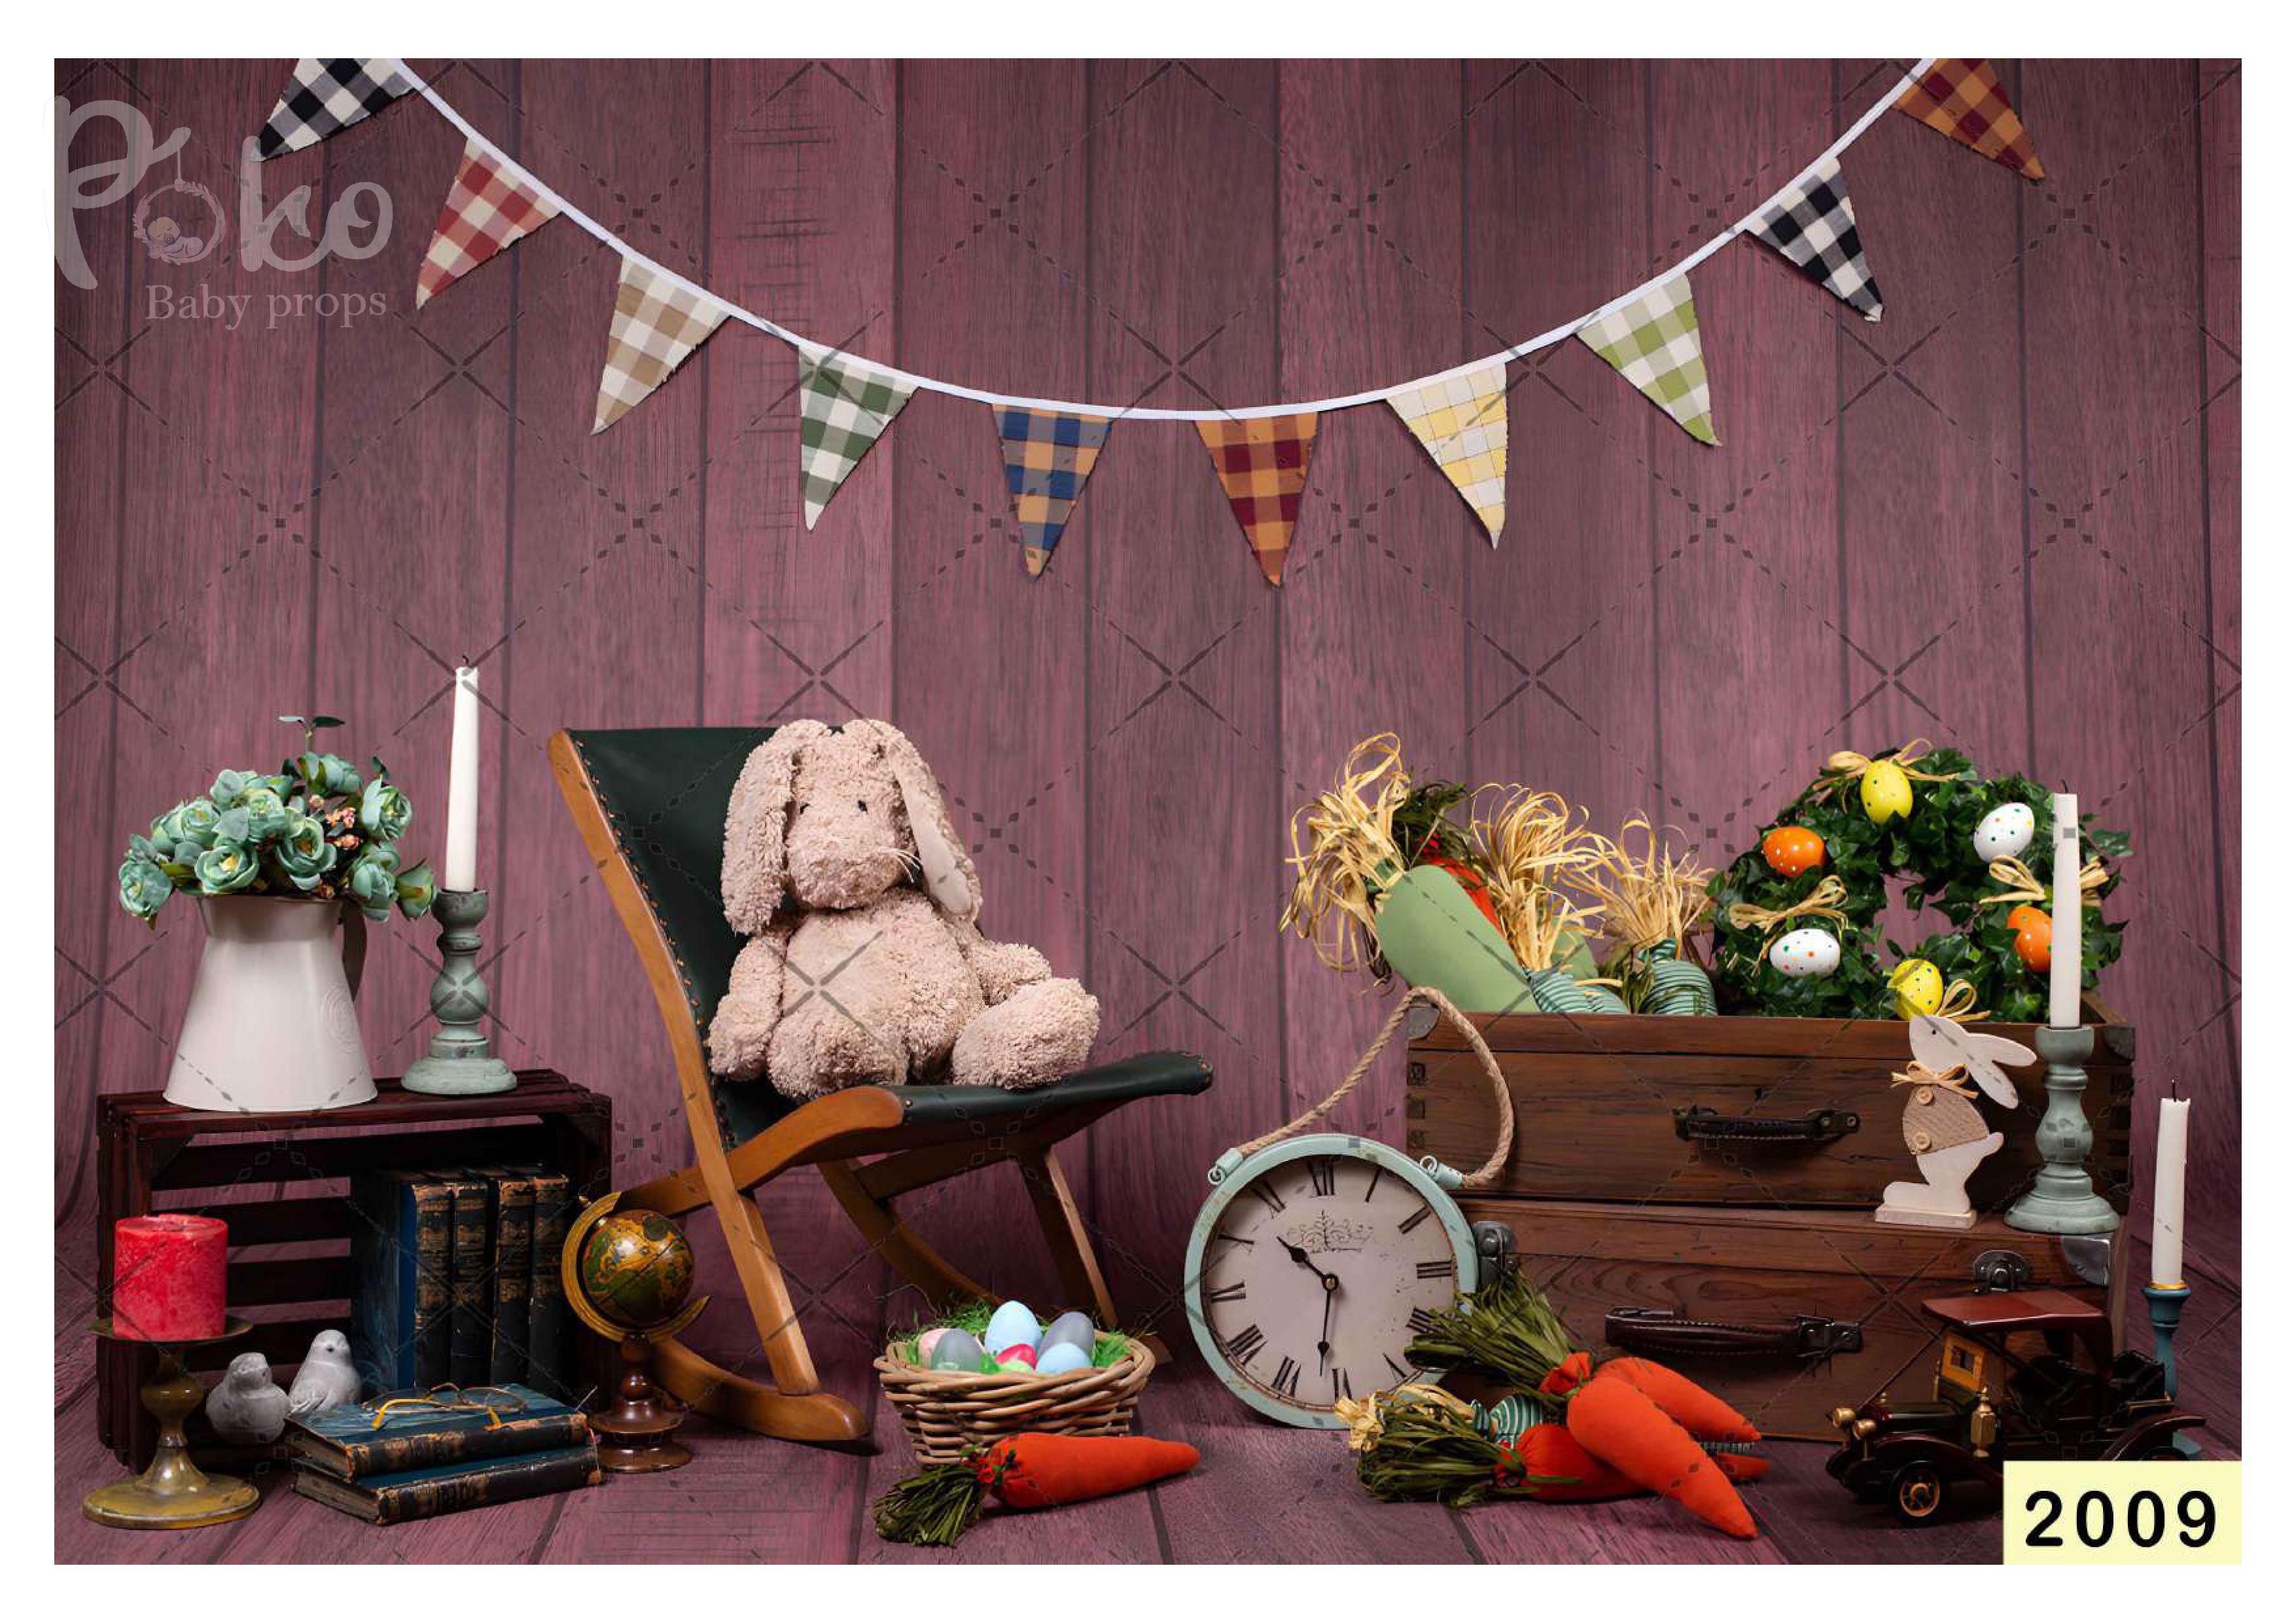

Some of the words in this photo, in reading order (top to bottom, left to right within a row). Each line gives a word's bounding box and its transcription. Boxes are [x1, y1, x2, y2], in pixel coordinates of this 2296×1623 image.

[1307, 1158, 1335, 1198] XII
[1364, 1168, 1382, 1202] I
[1398, 1204, 1431, 1234] II
[1416, 1258, 1453, 1281] III
[1227, 1323, 1268, 1366] VIII
[1271, 1355, 1301, 1397] VII
